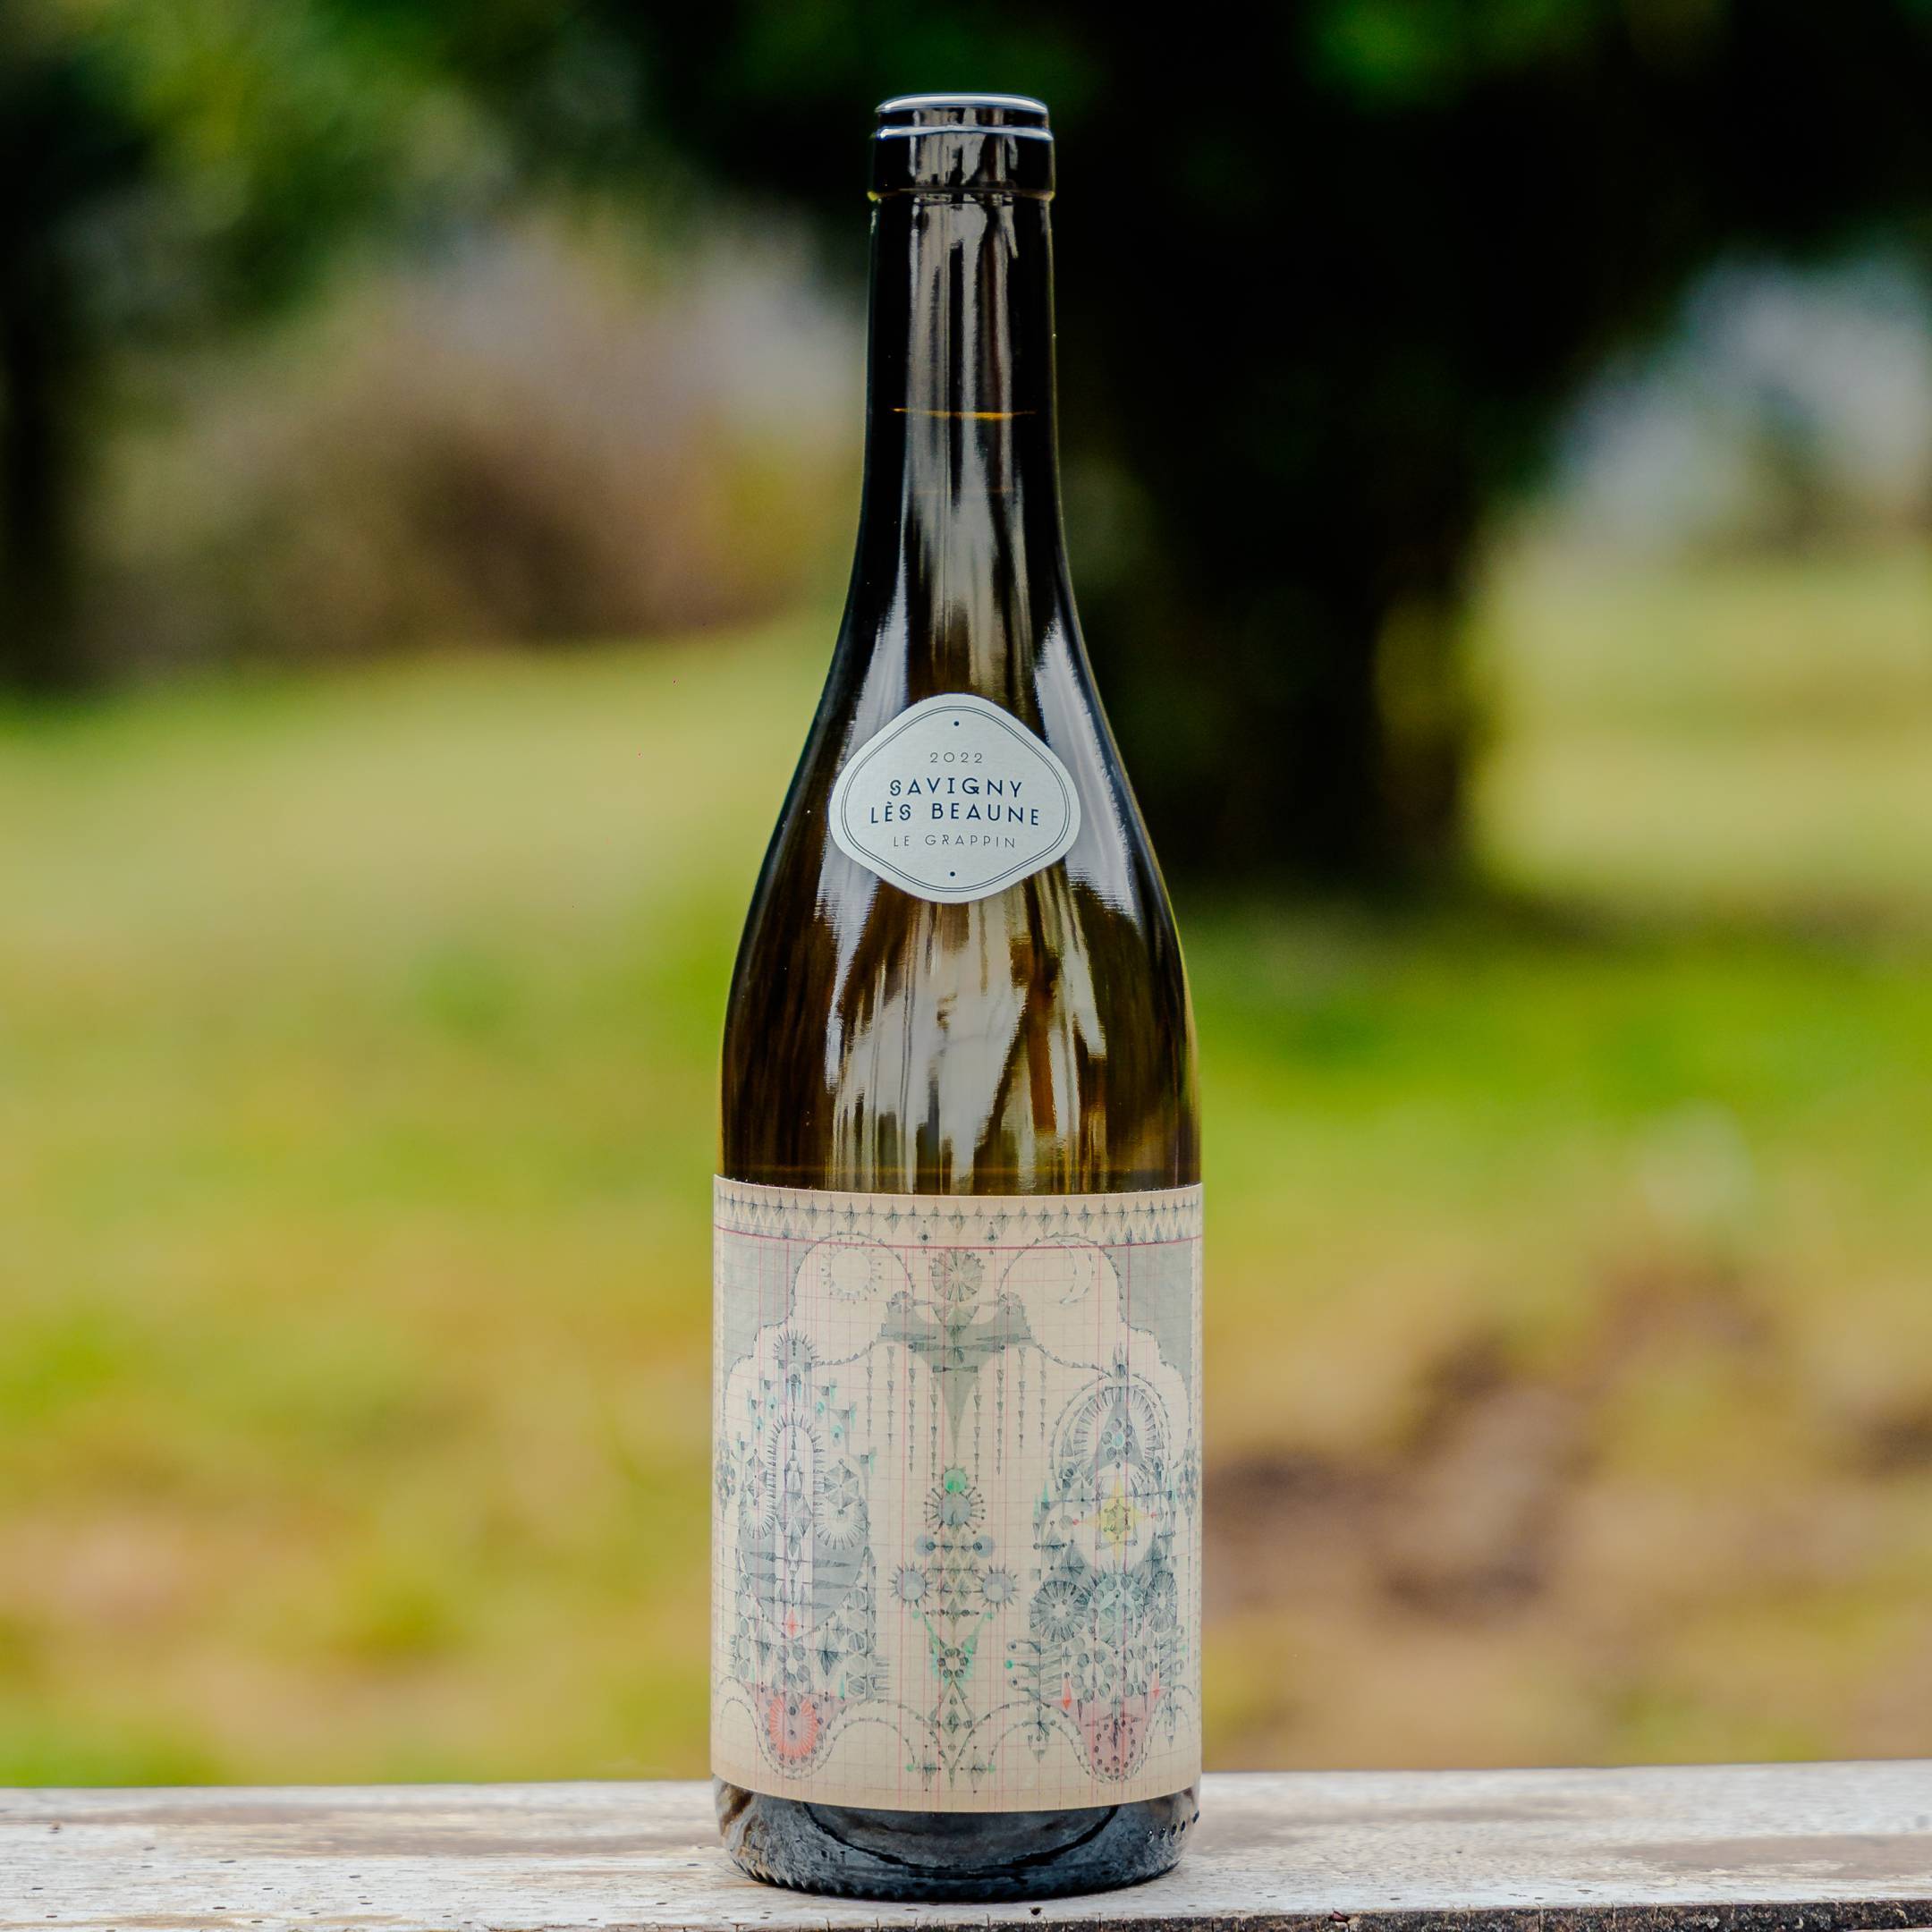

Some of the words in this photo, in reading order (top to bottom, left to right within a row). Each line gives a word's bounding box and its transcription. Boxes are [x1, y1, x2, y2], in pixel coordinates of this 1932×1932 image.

[929, 751, 983, 764] 2022
[889, 777, 1023, 798] SAVIGNY
[869, 801, 911, 824] LÈS
[931, 802, 1039, 826] BEAUNE
[894, 835, 910, 847] LE
[925, 834, 1016, 848] GRAPPIN
